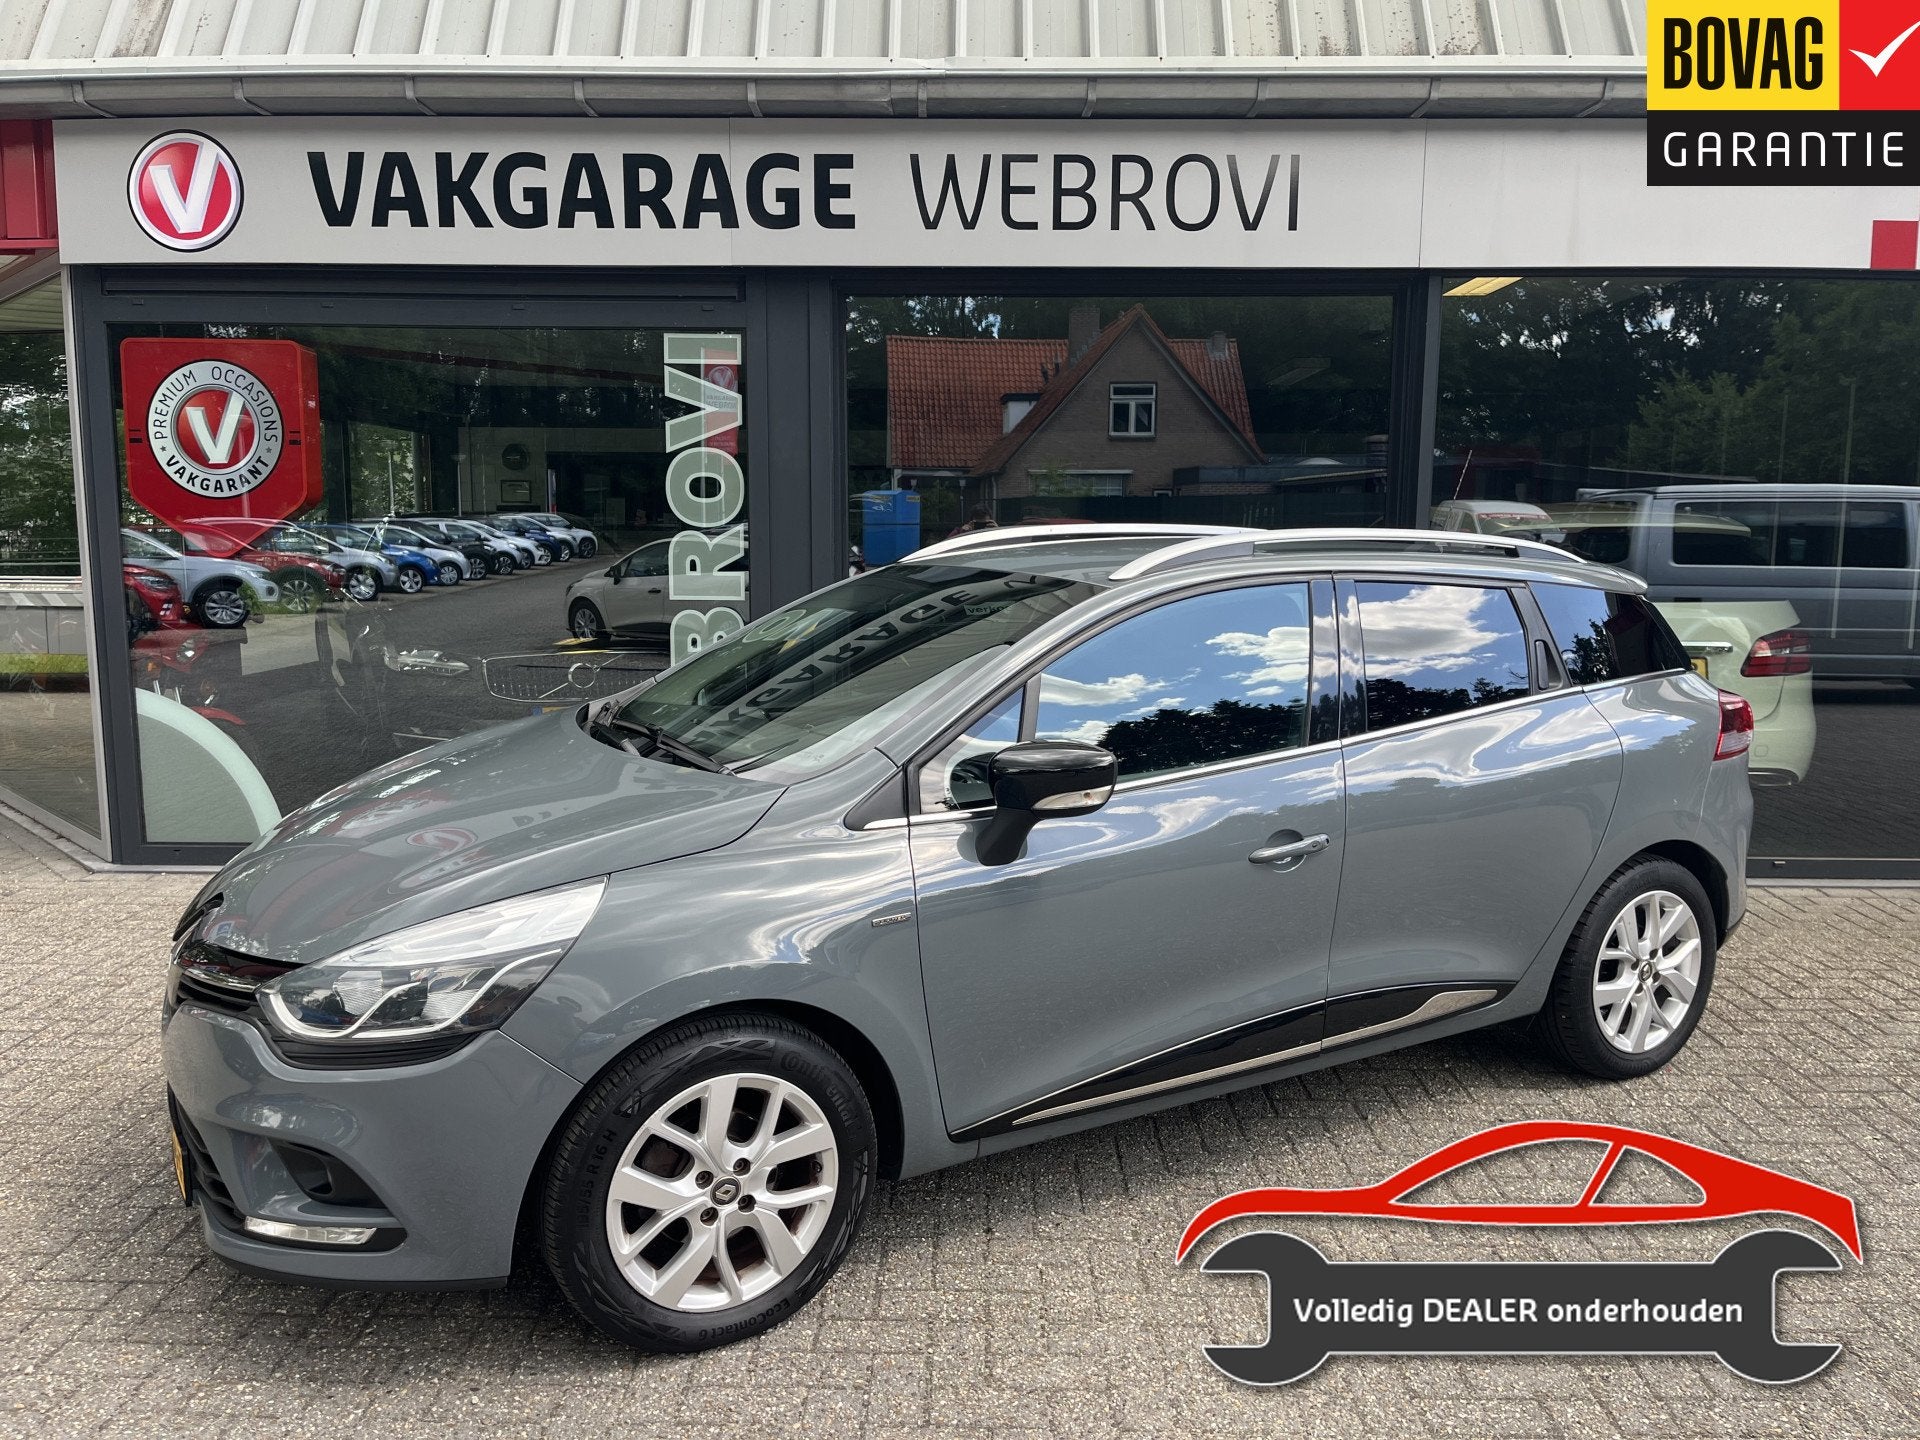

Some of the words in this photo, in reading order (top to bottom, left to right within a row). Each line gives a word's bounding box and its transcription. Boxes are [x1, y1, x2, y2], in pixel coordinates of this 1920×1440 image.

[307, 151, 856, 229] VAKGARAGE
[910, 153, 1301, 231] WEBROVI
[153, 369, 197, 440] PREMIUM
[211, 366, 278, 443] OCCASIONS
[166, 454, 269, 493] VAKGARANT
